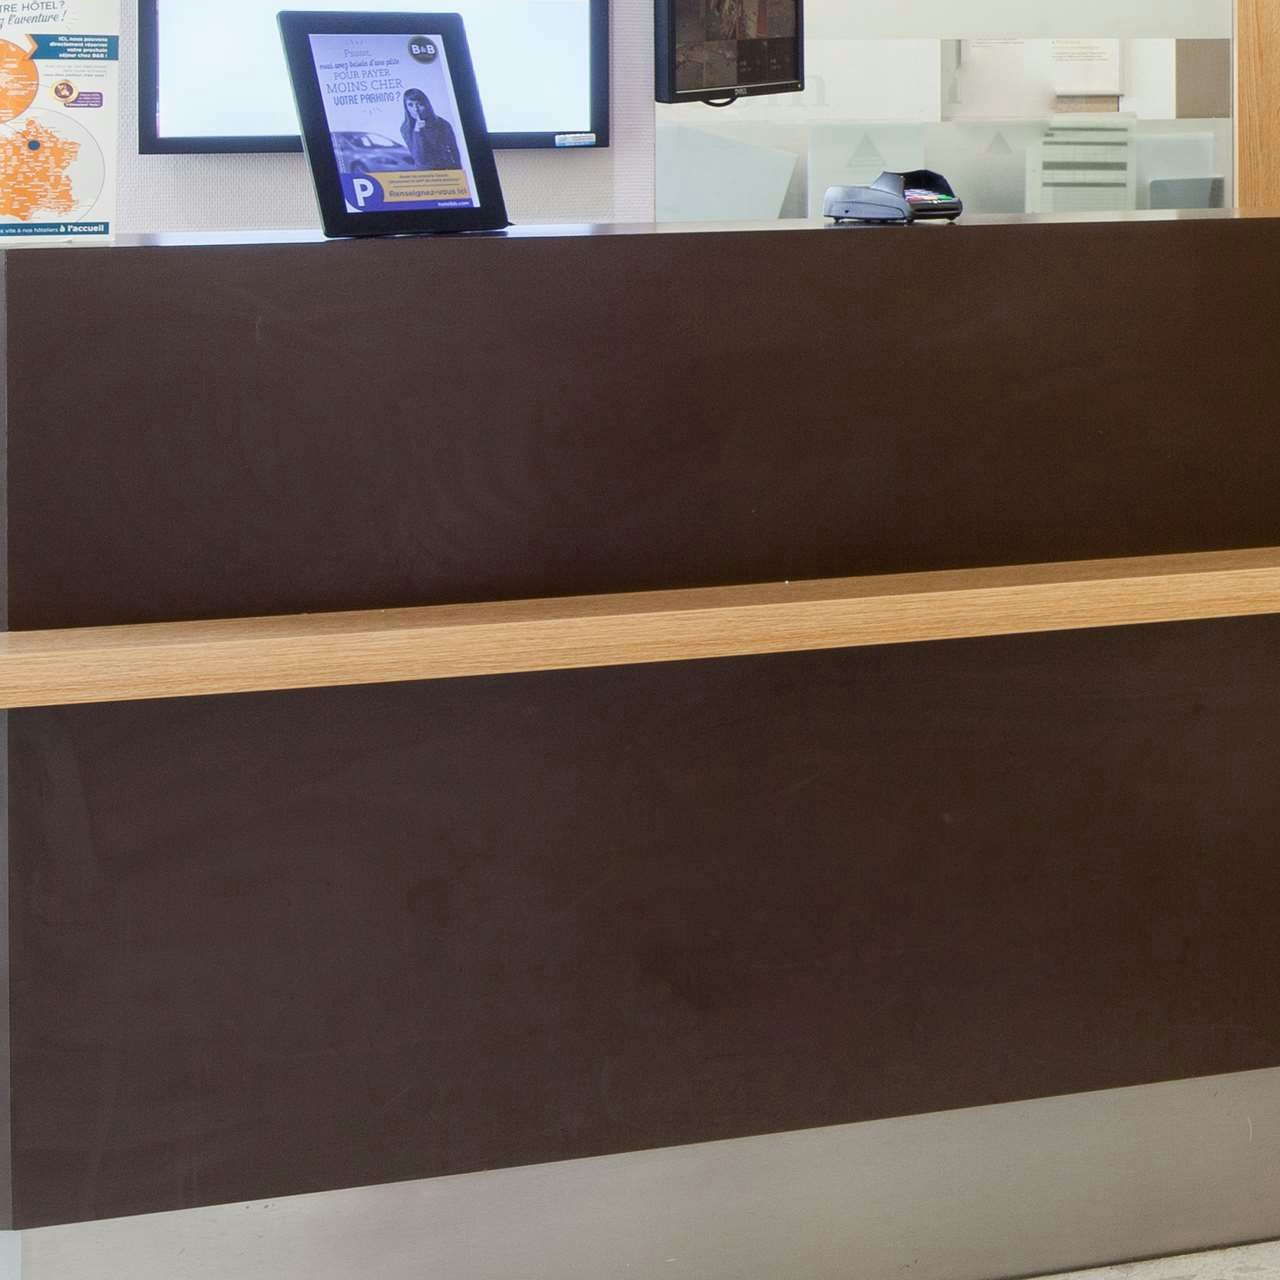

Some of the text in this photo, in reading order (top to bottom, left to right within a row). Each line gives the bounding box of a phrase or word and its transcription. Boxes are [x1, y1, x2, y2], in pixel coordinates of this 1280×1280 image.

[22, 1, 57, 12] HÔTEL
[411, 44, 435, 55] B&B
[326, 78, 404, 94] MOINS CHER
[353, 178, 374, 207] P
[67, 224, 104, 232] l'accueil
